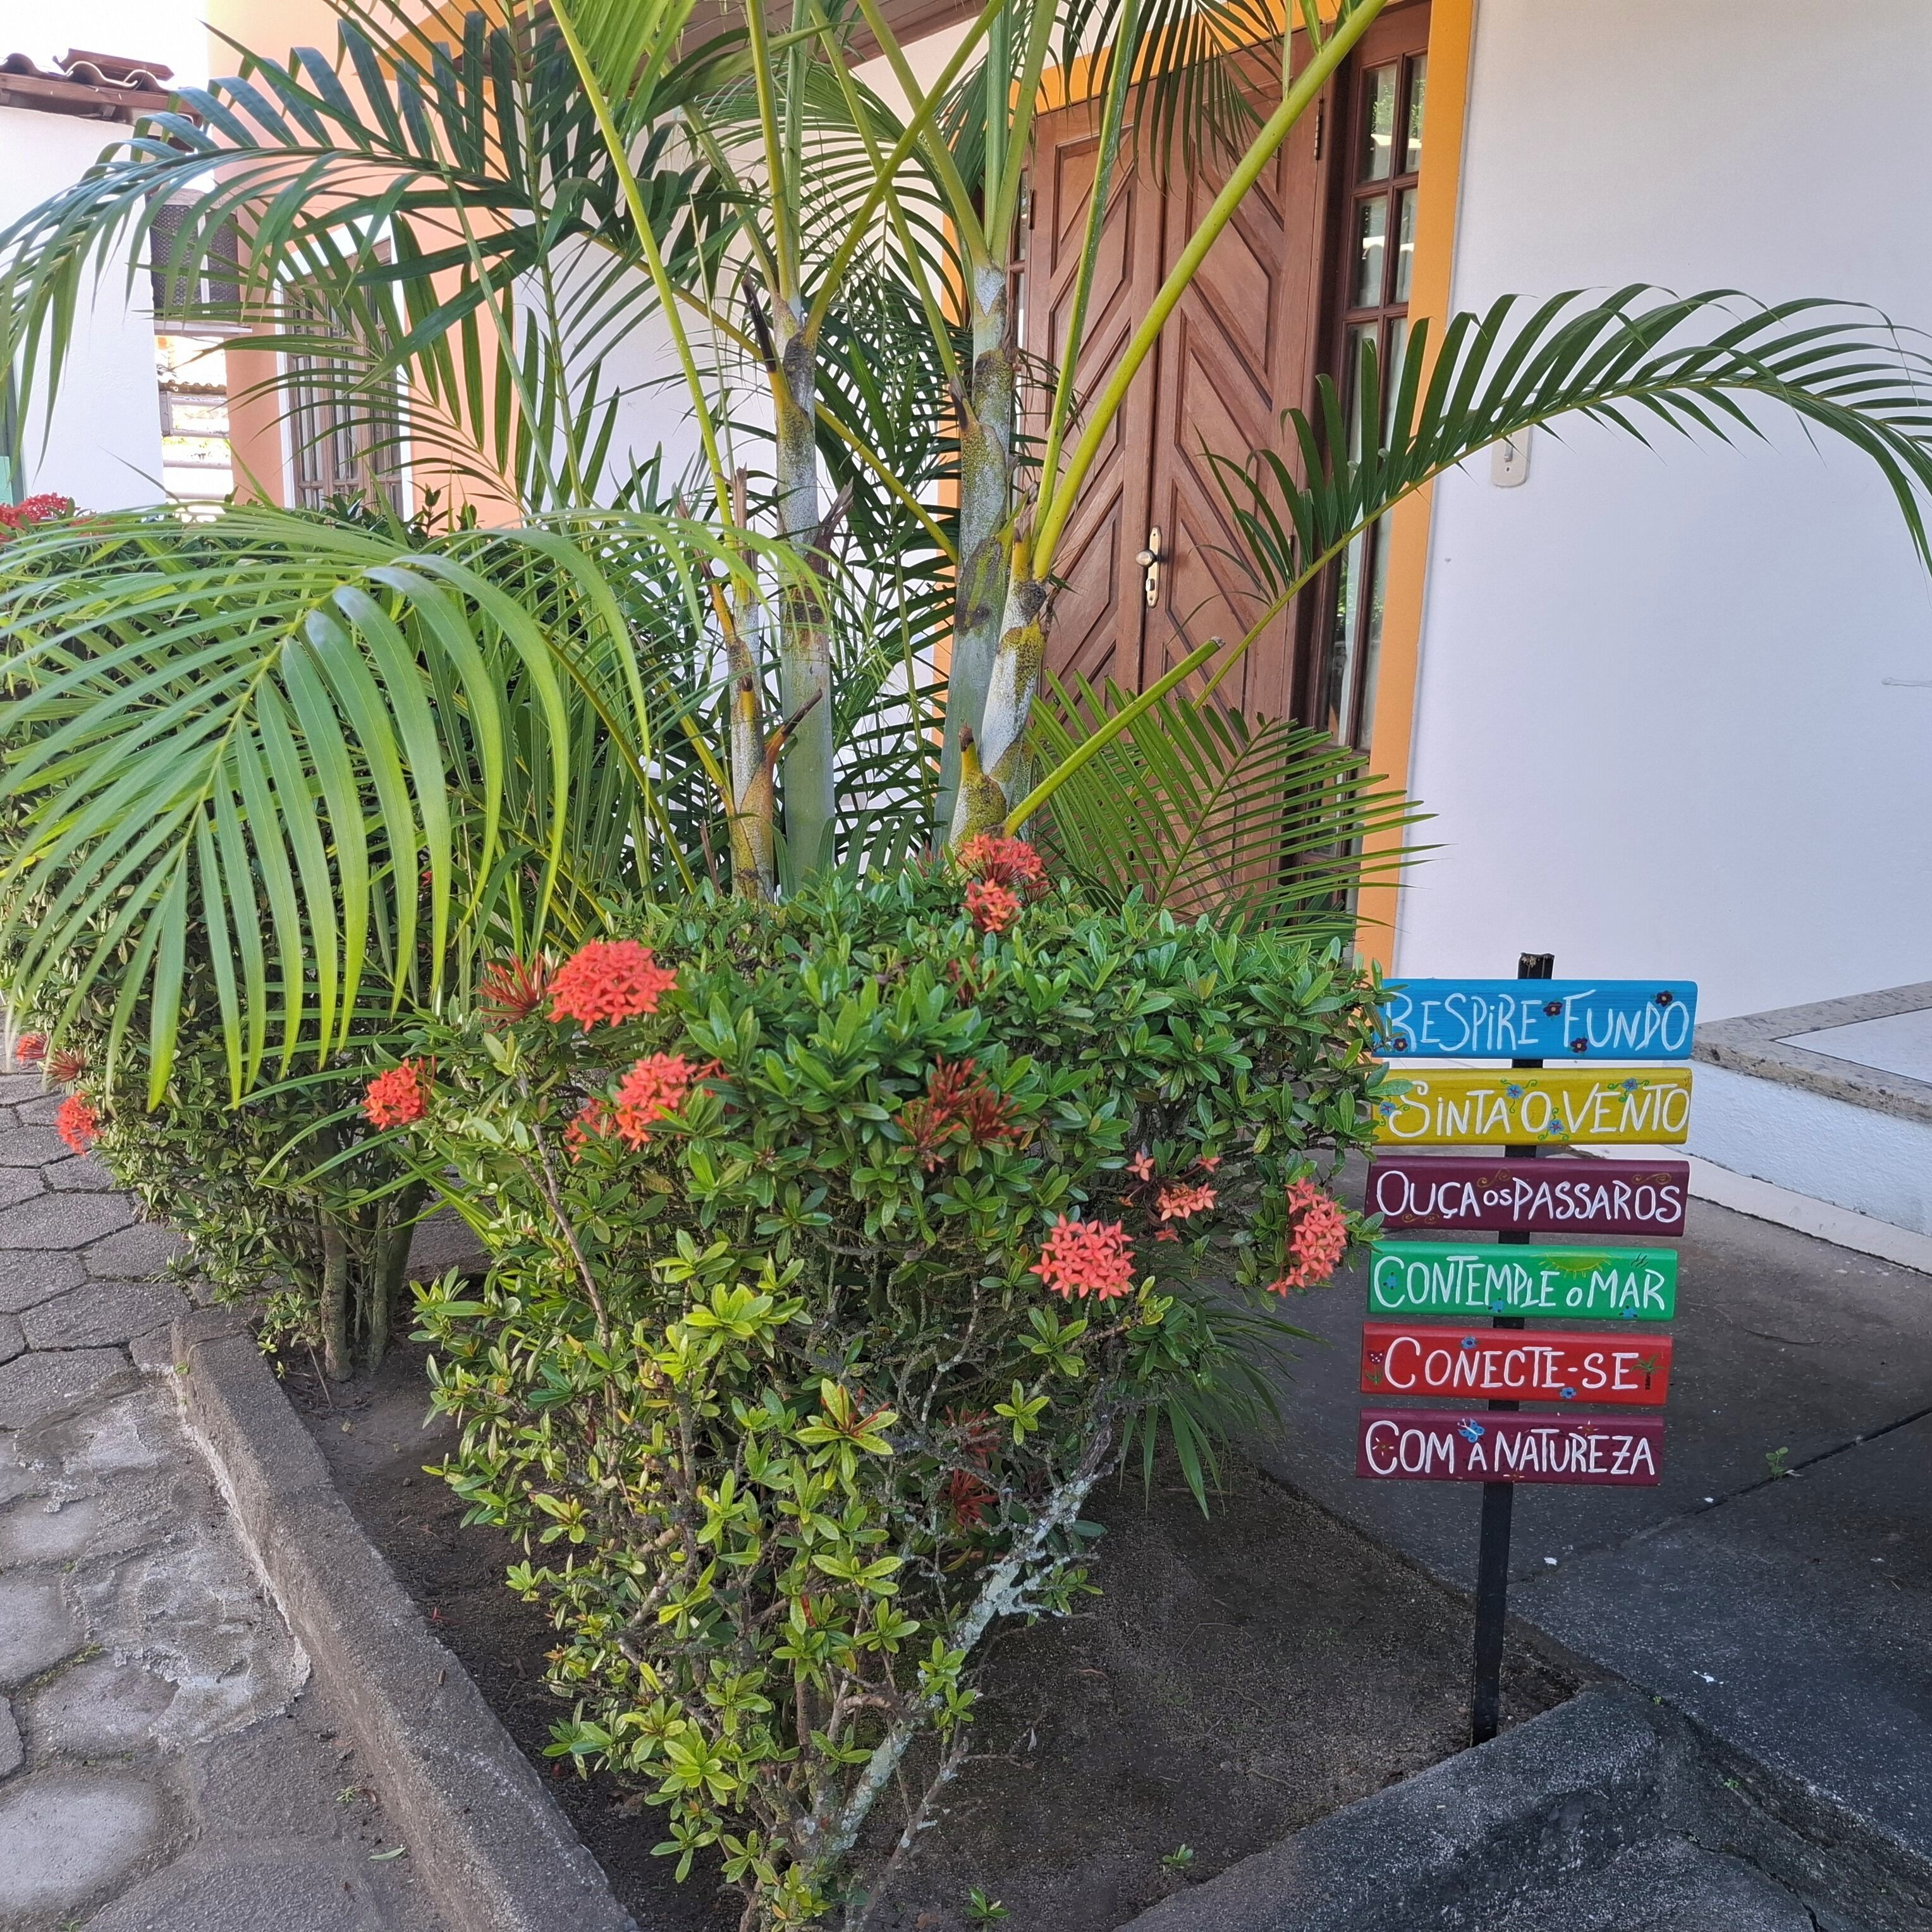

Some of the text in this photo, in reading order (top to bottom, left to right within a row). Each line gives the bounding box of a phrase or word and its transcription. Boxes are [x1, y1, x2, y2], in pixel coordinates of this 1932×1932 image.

[1563, 989, 1690, 1051] FUNDO
[1520, 1091, 1551, 1134] O
[1562, 1082, 1689, 1134] VENTO
[1376, 1170, 1481, 1220] OUÇA
[1512, 1177, 1684, 1223] PASSAROS
[1374, 1256, 1560, 1308] CONTEMPLE
[1587, 1269, 1665, 1310] MAR
[1385, 1336, 1639, 1390] CONECTE-SE
[1366, 1420, 1655, 1476] COM A NATUREZA
